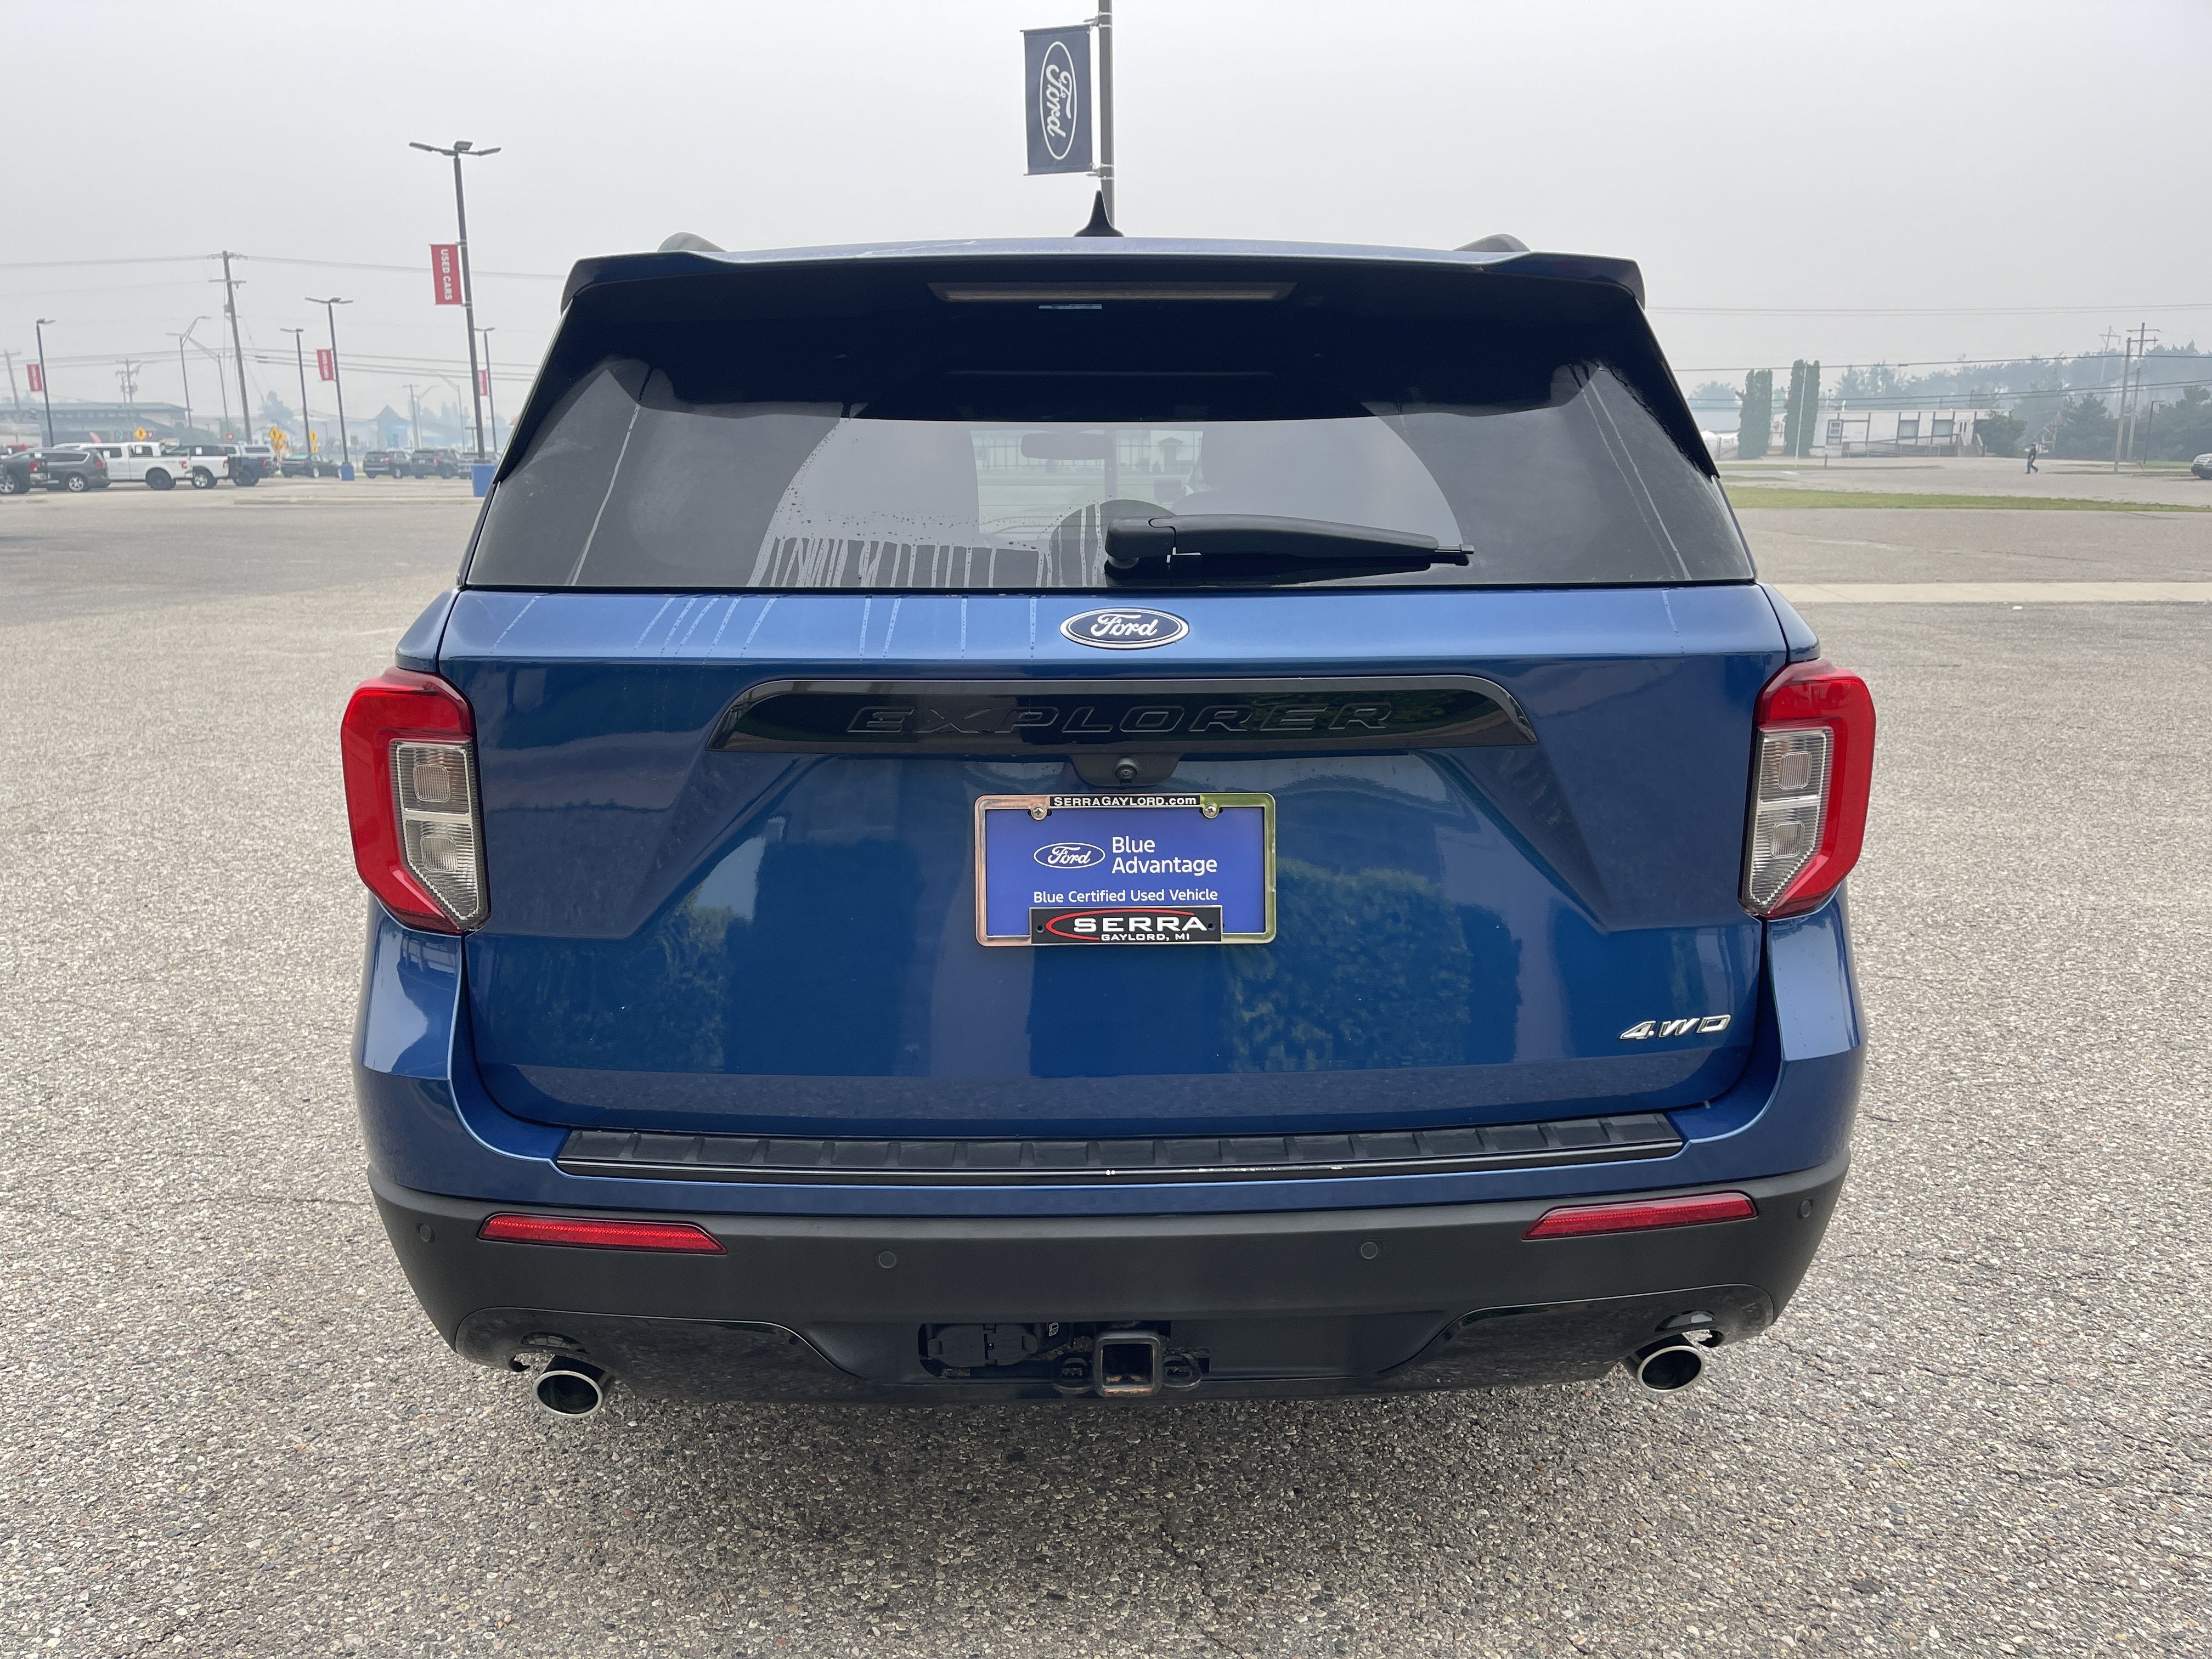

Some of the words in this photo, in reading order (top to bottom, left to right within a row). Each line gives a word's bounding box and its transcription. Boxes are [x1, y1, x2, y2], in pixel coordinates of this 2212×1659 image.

[1045, 64, 1072, 138] Ford
[441, 249, 450, 274] USED
[443, 275, 453, 301] CARS
[1090, 613, 1159, 636] Ford
[847, 703, 1392, 733] EXPLORER
[1047, 845, 1092, 864] Ford
[1112, 836, 1155, 853] Blue
[1111, 856, 1217, 876] Advantage
[1034, 891, 1064, 903] Blue
[1069, 889, 1126, 902] Certified
[1131, 889, 1165, 901] Used
[1169, 888, 1218, 901] Vehicle
[1073, 916, 1207, 933] SERRA
[1620, 1014, 1731, 1040] 4WD
